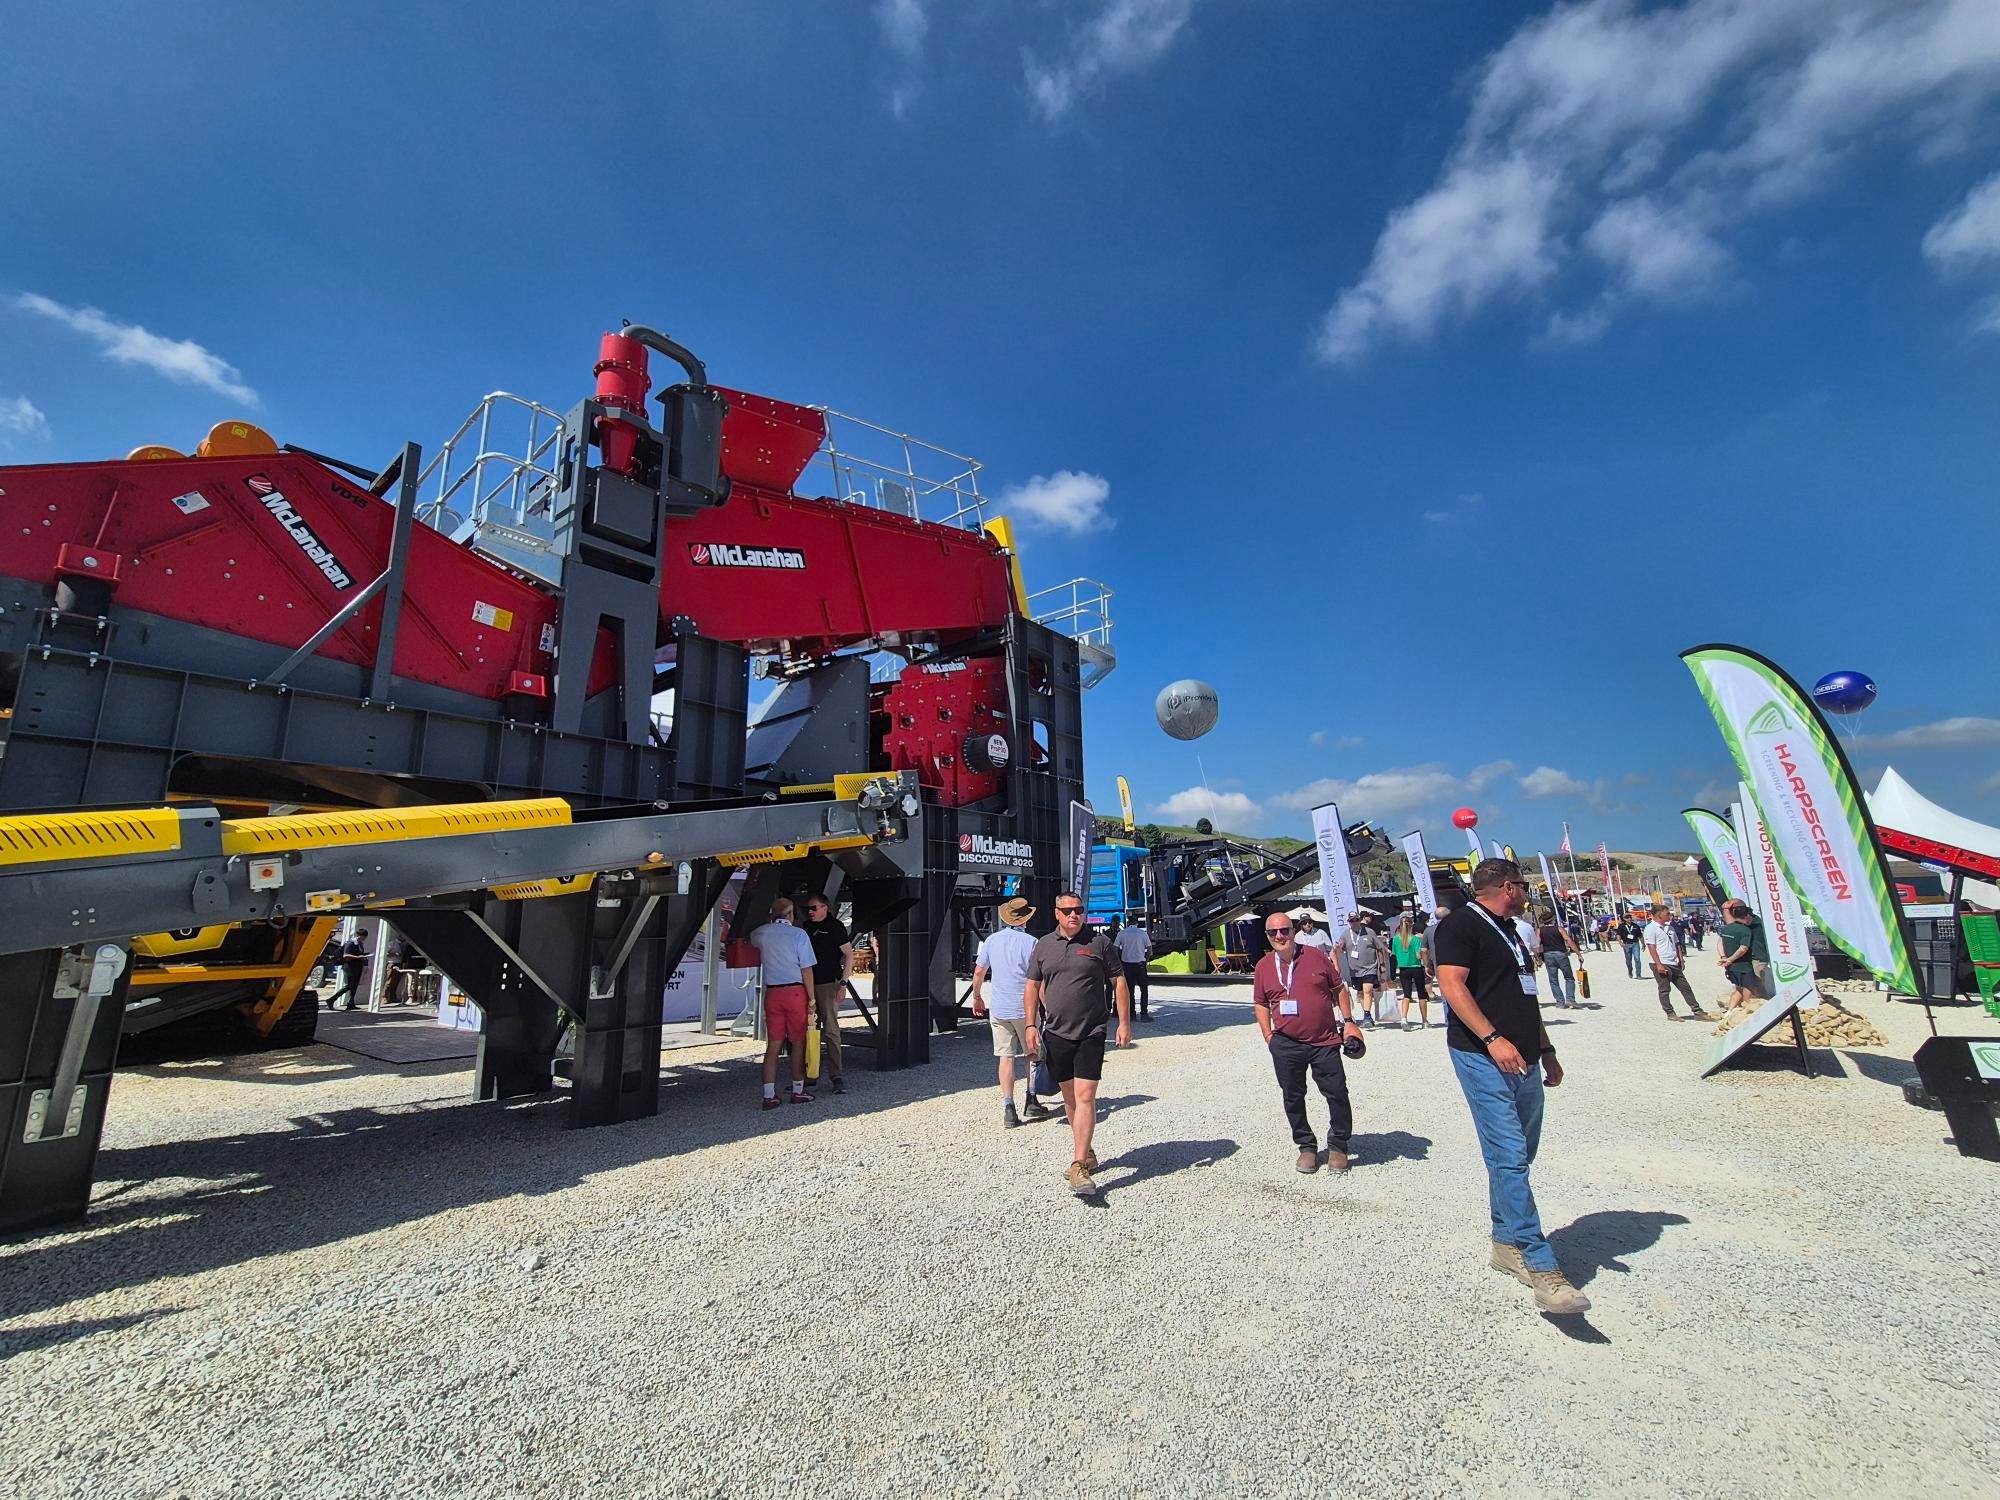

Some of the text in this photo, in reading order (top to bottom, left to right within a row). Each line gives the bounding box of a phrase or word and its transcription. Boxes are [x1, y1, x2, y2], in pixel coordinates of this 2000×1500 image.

[330, 480, 368, 509] VD15
[260, 491, 350, 590] McLanahan
[708, 544, 804, 569] McLanahan
[926, 661, 967, 674] McLanahan
[1760, 750, 1784, 791] SCREENING
[1783, 799, 1807, 844] RECYCLING
[1774, 743, 1852, 900] HARPSCREEN
[971, 834, 1033, 858] McLanahan
[959, 853, 1034, 867] DISCOVERY 3020
[1326, 853, 1348, 927] iProvide Ltd
[667, 981, 681, 990] RT
[671, 970, 685, 979] ON
